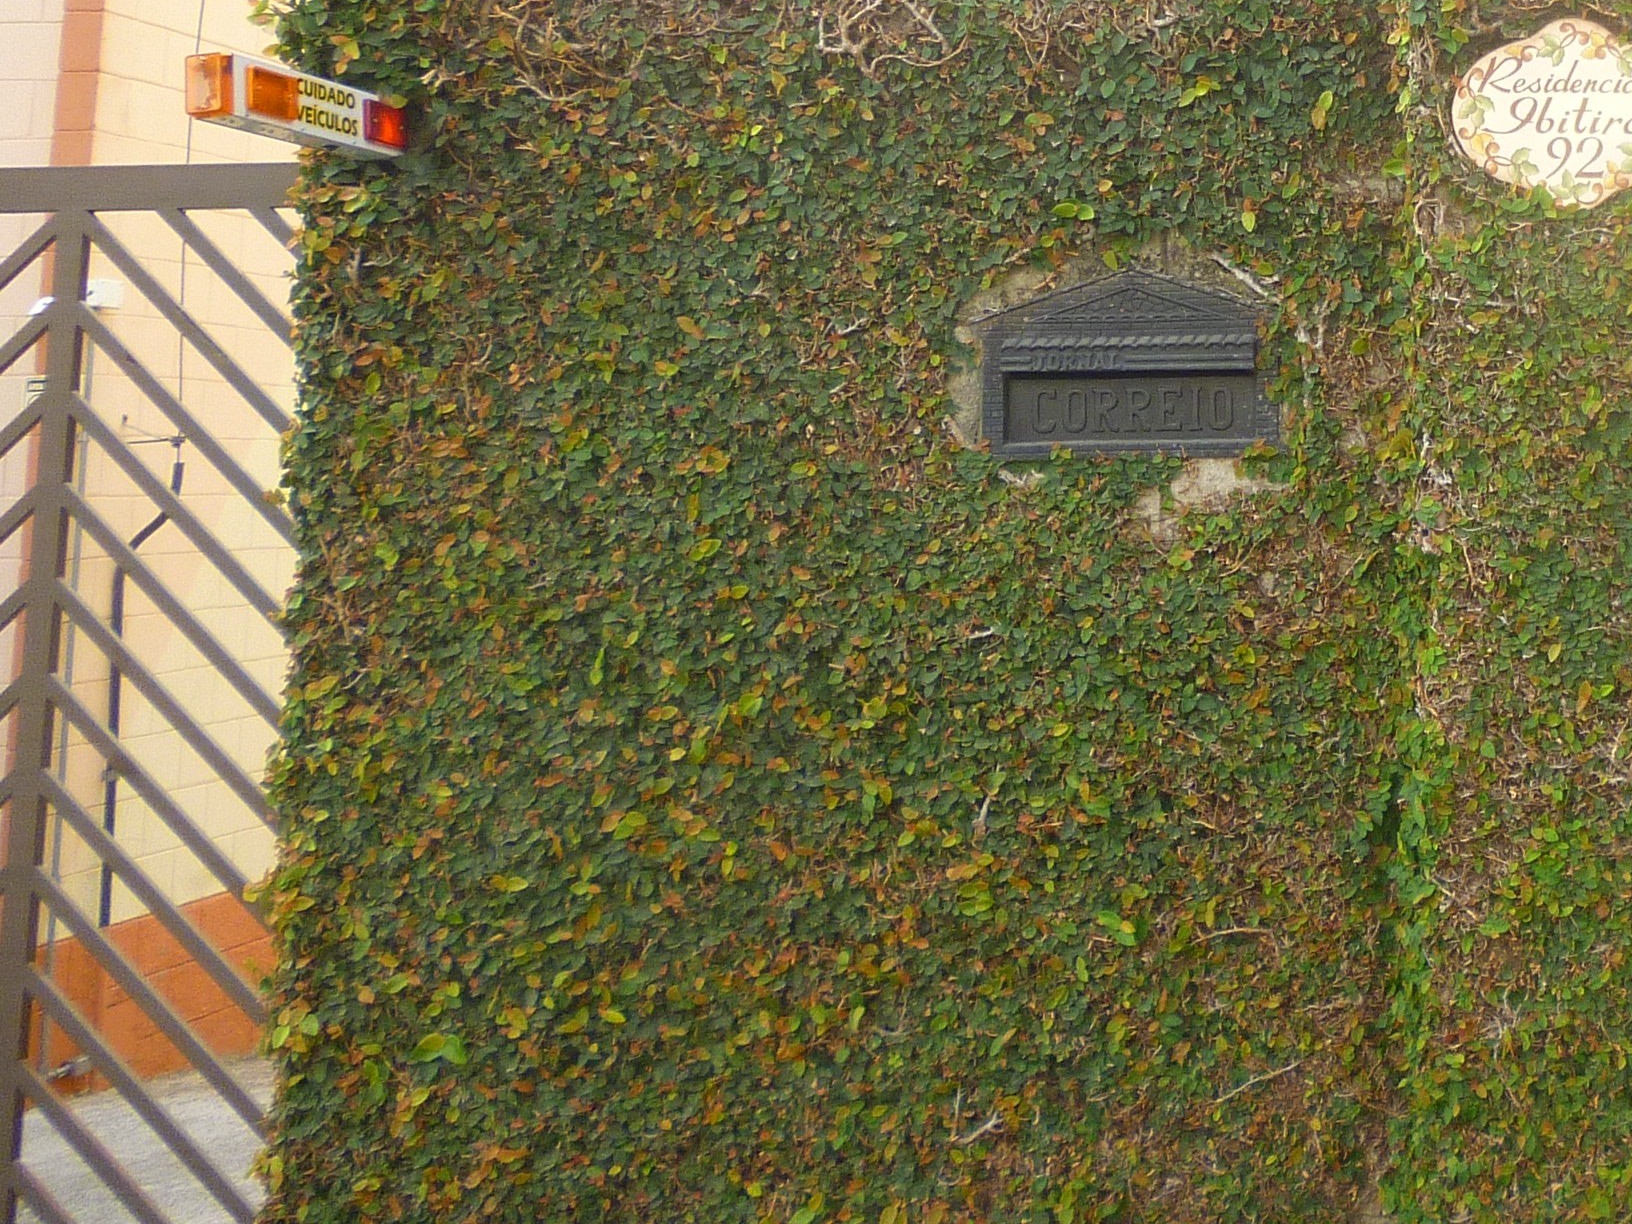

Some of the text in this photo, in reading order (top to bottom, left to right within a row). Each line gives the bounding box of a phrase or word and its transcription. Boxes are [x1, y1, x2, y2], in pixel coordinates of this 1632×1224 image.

[297, 78, 356, 109] CUIDADO
[1546, 137, 1605, 179] 92
[1032, 385, 1234, 434] CORREIO
